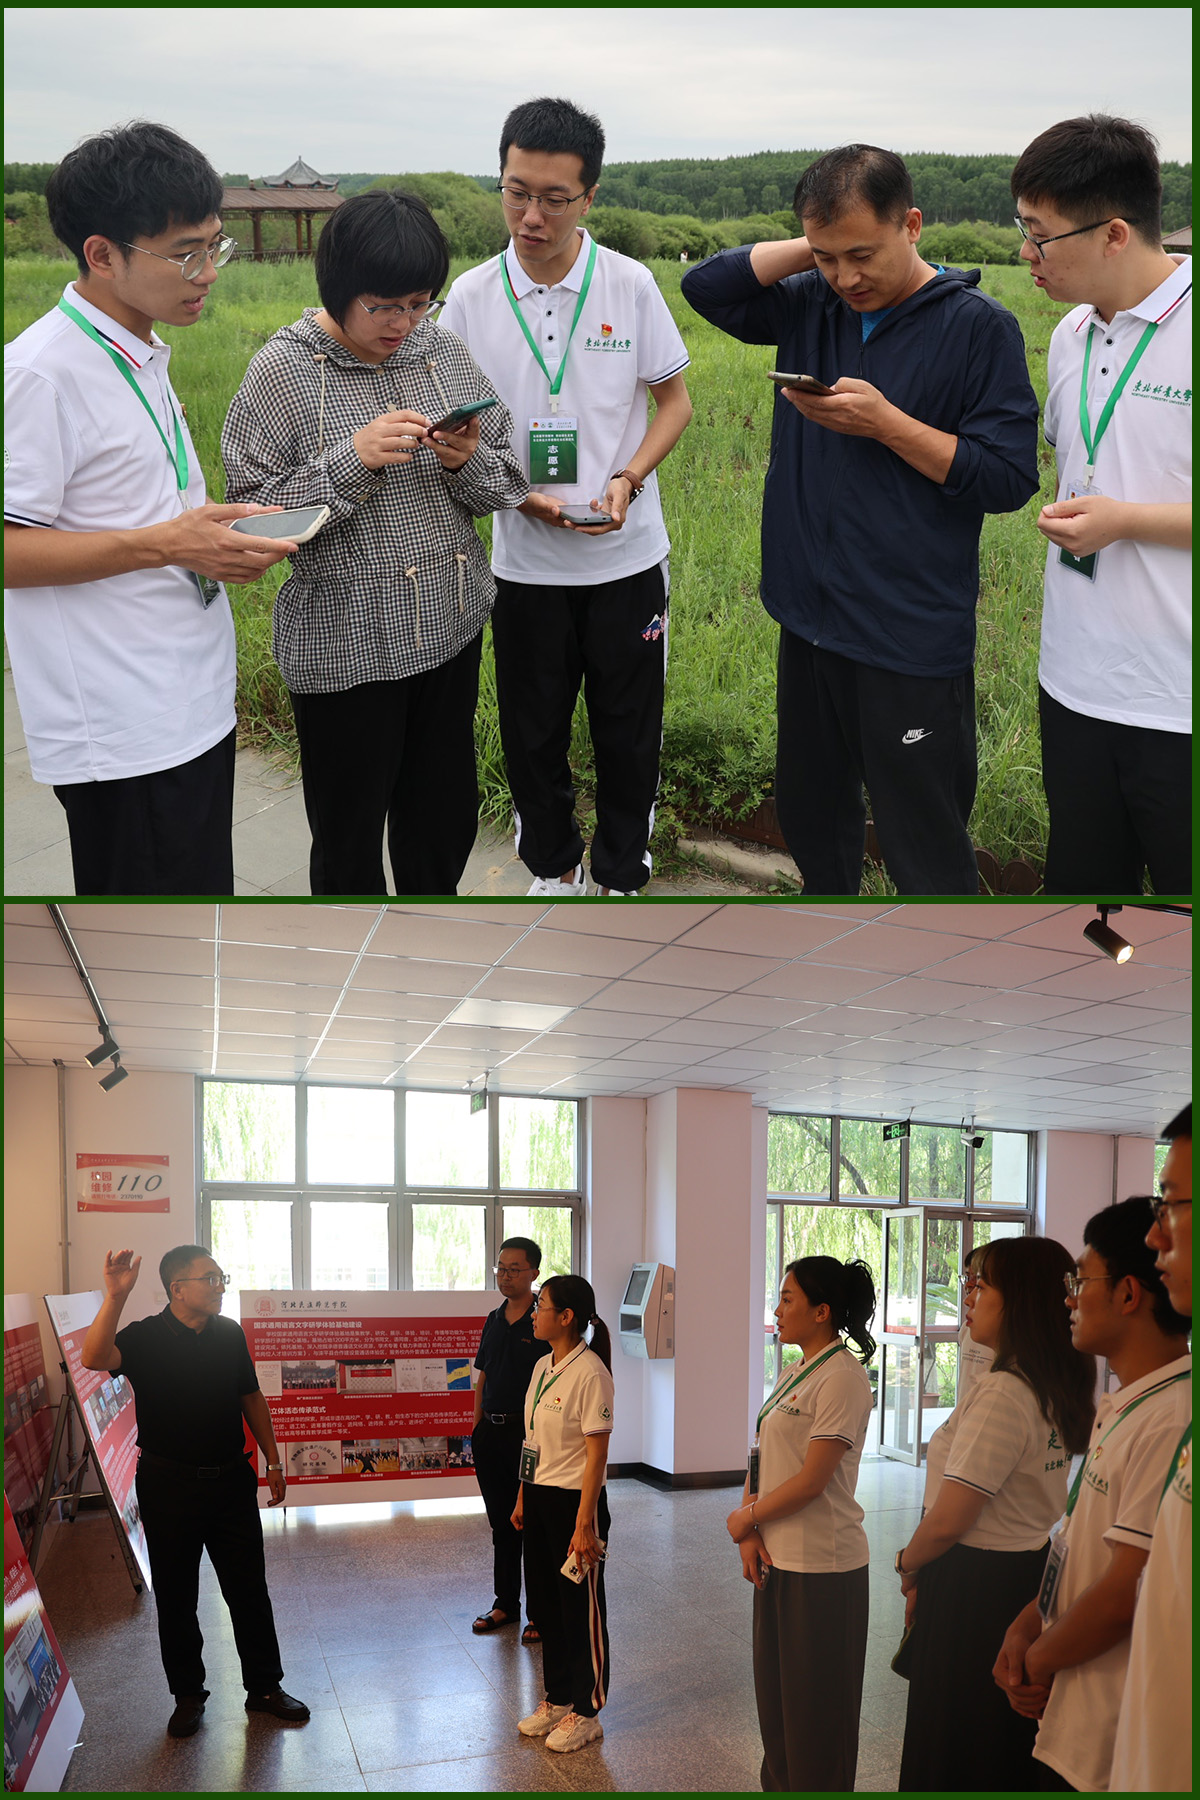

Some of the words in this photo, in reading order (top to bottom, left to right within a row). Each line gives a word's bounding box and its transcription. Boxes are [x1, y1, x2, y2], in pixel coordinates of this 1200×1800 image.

[547, 444, 559, 477] 志愿者
[906, 728, 925, 739] NIKE
[91, 1171, 112, 1181] 校园
[91, 1182, 112, 1193] 维修
[116, 1174, 163, 1192] 110
[253, 1320, 363, 1330] 国家通用语言文字研学体验基地建设
[269, 1405, 327, 1415] 立体活态传承范式
